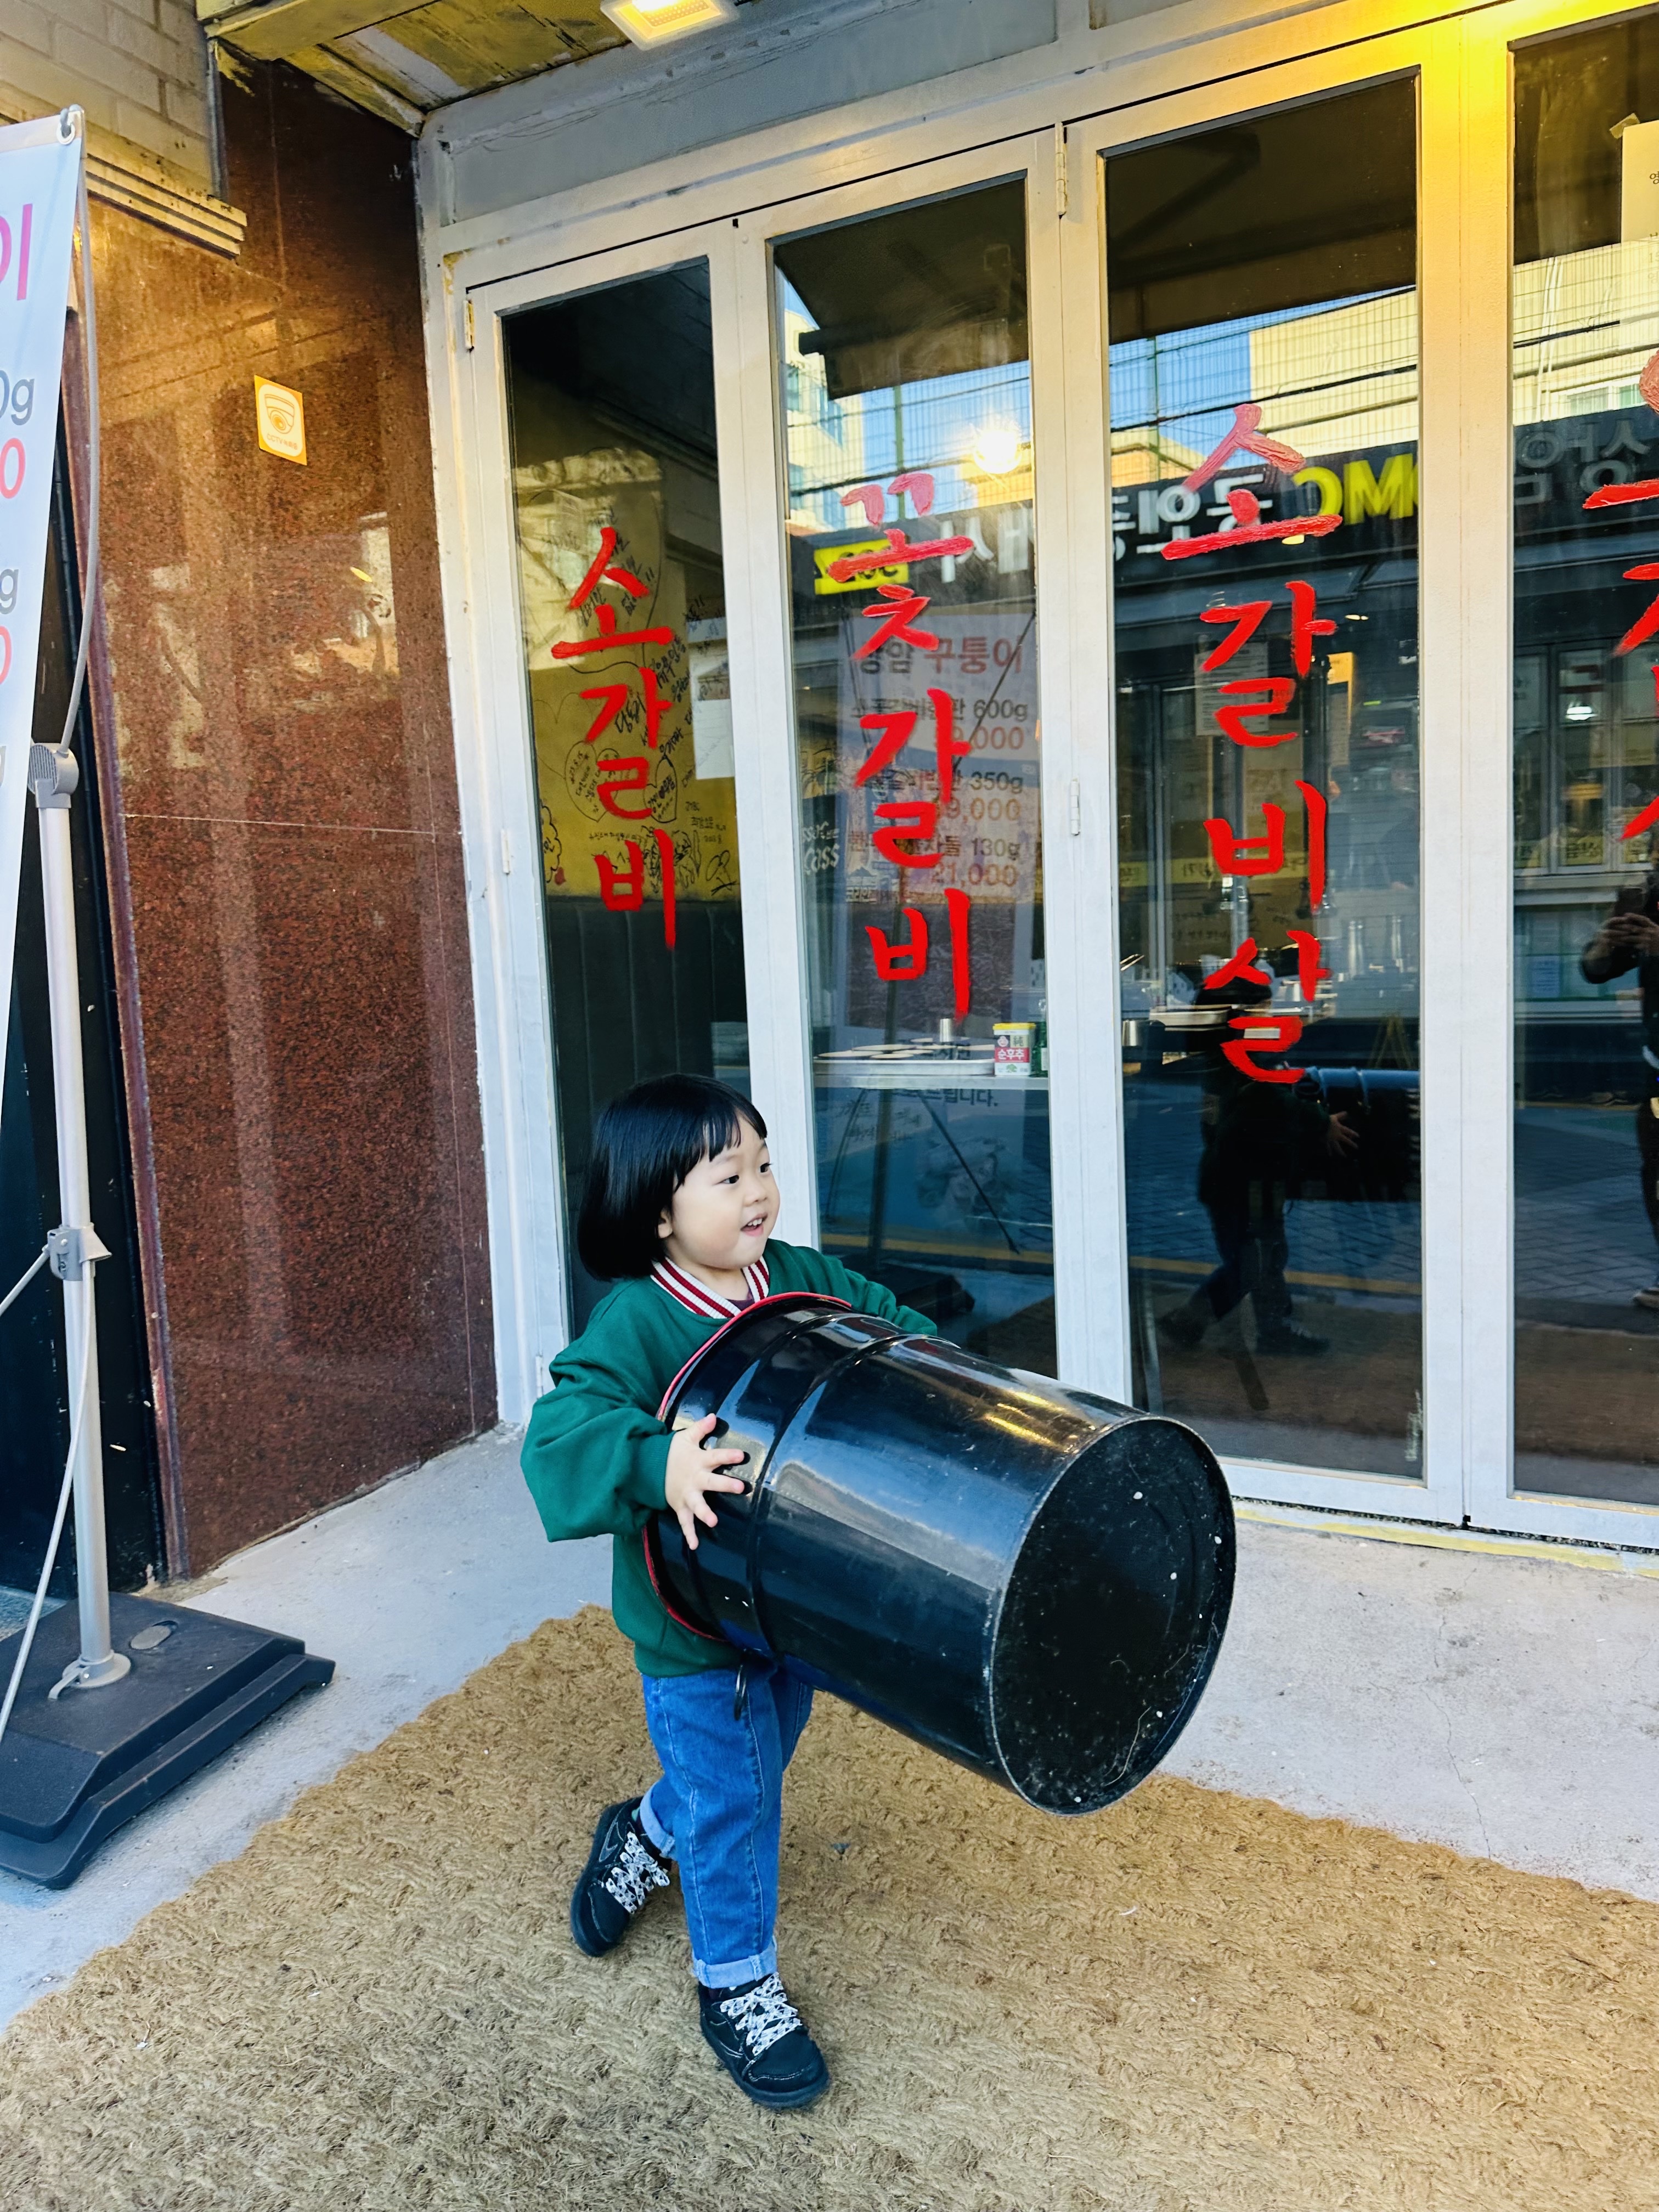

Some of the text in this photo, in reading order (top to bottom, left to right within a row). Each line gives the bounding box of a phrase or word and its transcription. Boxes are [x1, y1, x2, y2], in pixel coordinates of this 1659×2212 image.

[551, 527, 677, 950] 소갈비
[827, 473, 974, 1025] 꽃갈비
[1161, 403, 1343, 1084] 소갈비살
[997, 1048, 1025, 1060] 순후추
